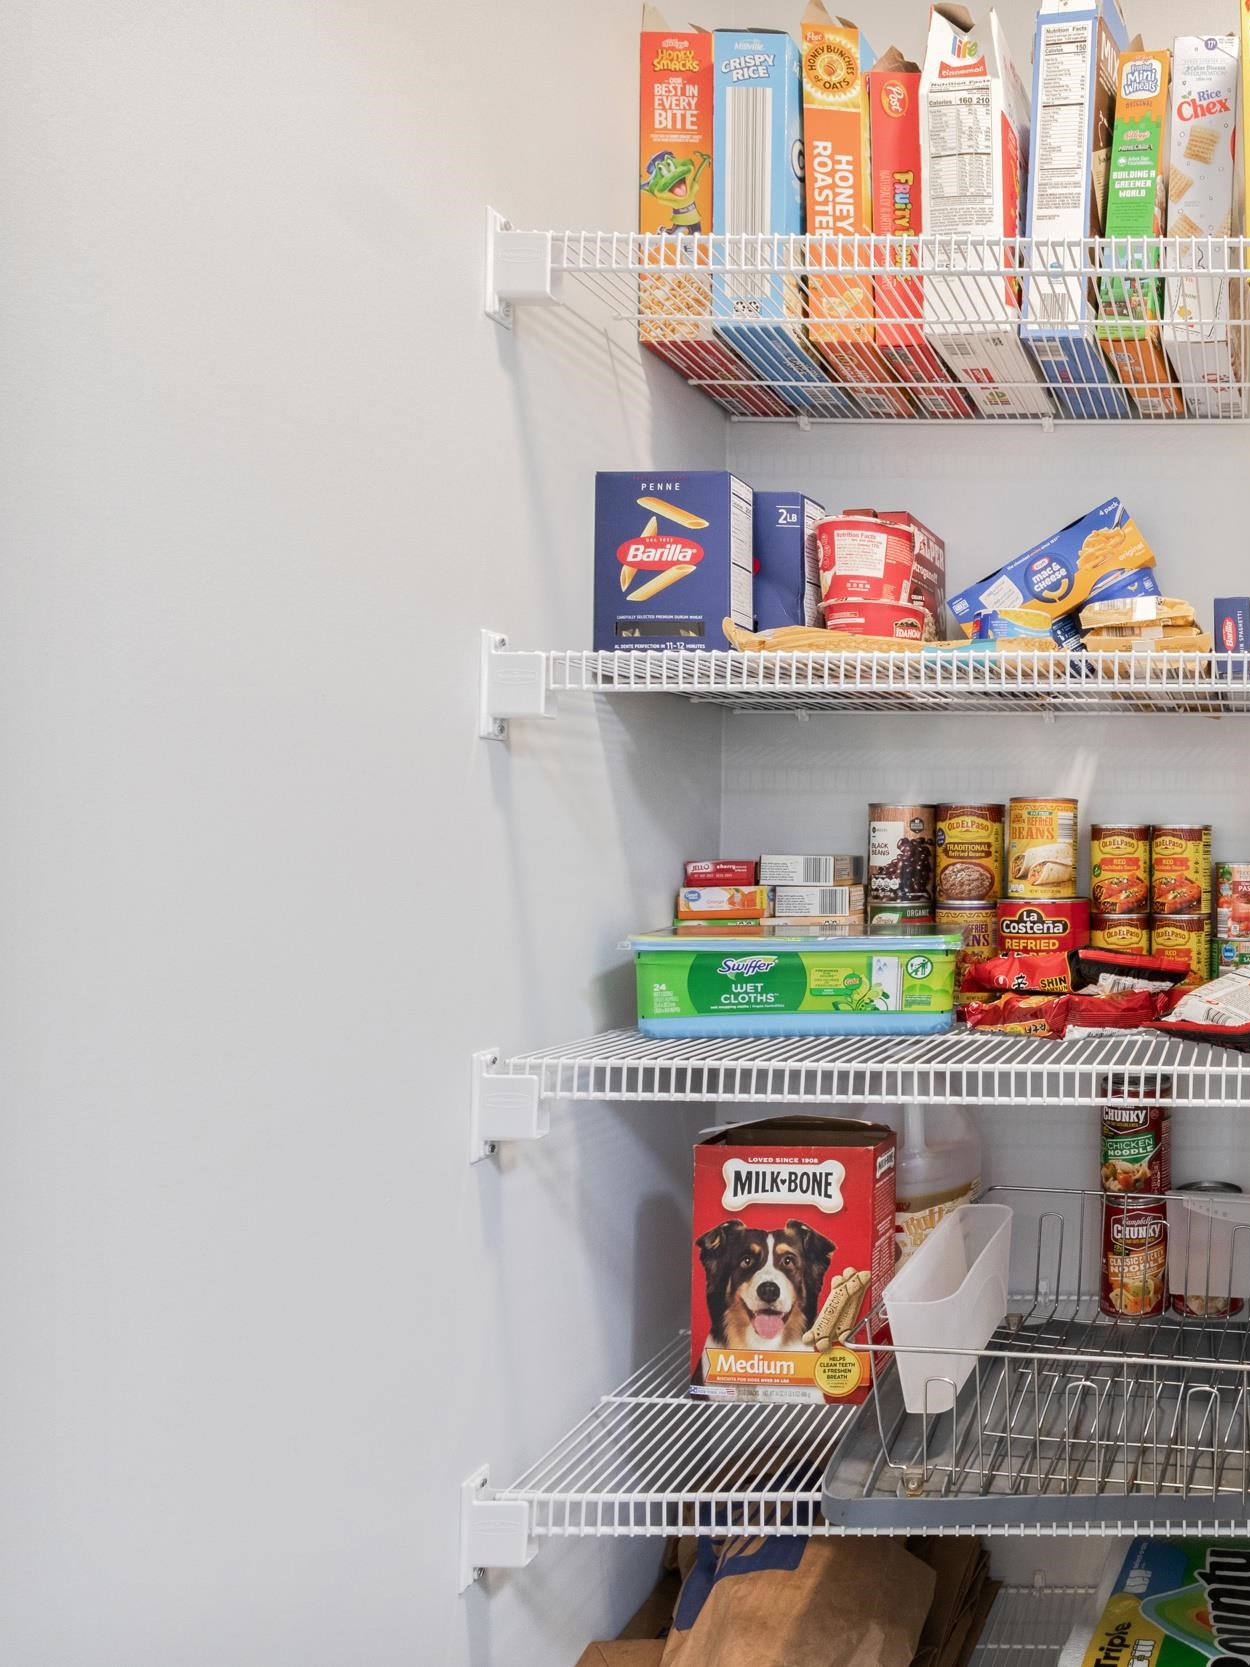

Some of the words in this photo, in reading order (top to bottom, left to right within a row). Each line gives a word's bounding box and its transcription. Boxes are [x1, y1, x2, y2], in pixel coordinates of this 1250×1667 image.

[951, 35, 978, 58] life
[657, 49, 695, 60] HONEY
[808, 45, 826, 71] HONEY
[826, 45, 855, 76] BUNCHES
[652, 59, 699, 72] SMACKS
[721, 53, 776, 73] CRISPY
[732, 69, 769, 82] RICE
[942, 66, 984, 76] cinnamon
[1126, 69, 1157, 84] Mini
[654, 84, 683, 96] BEST
[686, 84, 698, 96] IN
[823, 78, 851, 91] OATS
[1123, 81, 1158, 96] Wheats
[886, 84, 903, 114] Post
[959, 96, 973, 104] 160
[1197, 89, 1221, 102] Rice
[654, 96, 698, 110] EVERY
[1176, 98, 1231, 122] Chex
[654, 110, 698, 129] BITE
[1113, 171, 1148, 179] BUILDING
[1115, 180, 1152, 188] GREENER
[834, 155, 855, 233] HONEY
[893, 170, 914, 227] FRUITY
[1119, 190, 1146, 198] WORLD
[641, 483, 681, 491] PENNE
[1104, 501, 1119, 515] pack
[778, 508, 798, 524] 2LB
[627, 544, 693, 562] Barilla
[1032, 567, 1053, 584] mac
[1237, 610, 1245, 641] SPAGHETTI
[1225, 620, 1234, 647] Barilla
[666, 641, 685, 650] 11-12
[948, 821, 961, 831] OLD
[961, 819, 971, 829] EL
[1026, 817, 1054, 827] REFRIED
[1011, 827, 1055, 840] BEANS
[947, 843, 989, 851] TRADITIONAL
[1102, 839, 1112, 848] OLD
[871, 849, 890, 857] BEANS
[907, 909, 929, 917] ORGANIC
[1023, 911, 1038, 921] La
[1003, 920, 1064, 934] Costeña
[1106, 929, 1117, 938] OLD
[1005, 939, 1059, 950] REFRIED
[718, 959, 776, 976] Swiffer
[653, 983, 666, 991] 24
[732, 983, 764, 993] WET
[1040, 976, 1067, 989] SHIN
[720, 993, 775, 1003] CLOTHS
[1103, 1107, 1147, 1123] CHUNKY
[1107, 1137, 1153, 1150] CHICKEN
[1108, 1145, 1153, 1156] NOODLE
[1113, 1223, 1161, 1239] CHUNKY
[1109, 1256, 1139, 1267] CLASSIC
[1109, 1257, 1164, 1273] NOODLE
[716, 1354, 795, 1375] Medium
[1094, 1622, 1131, 1667] Triple
